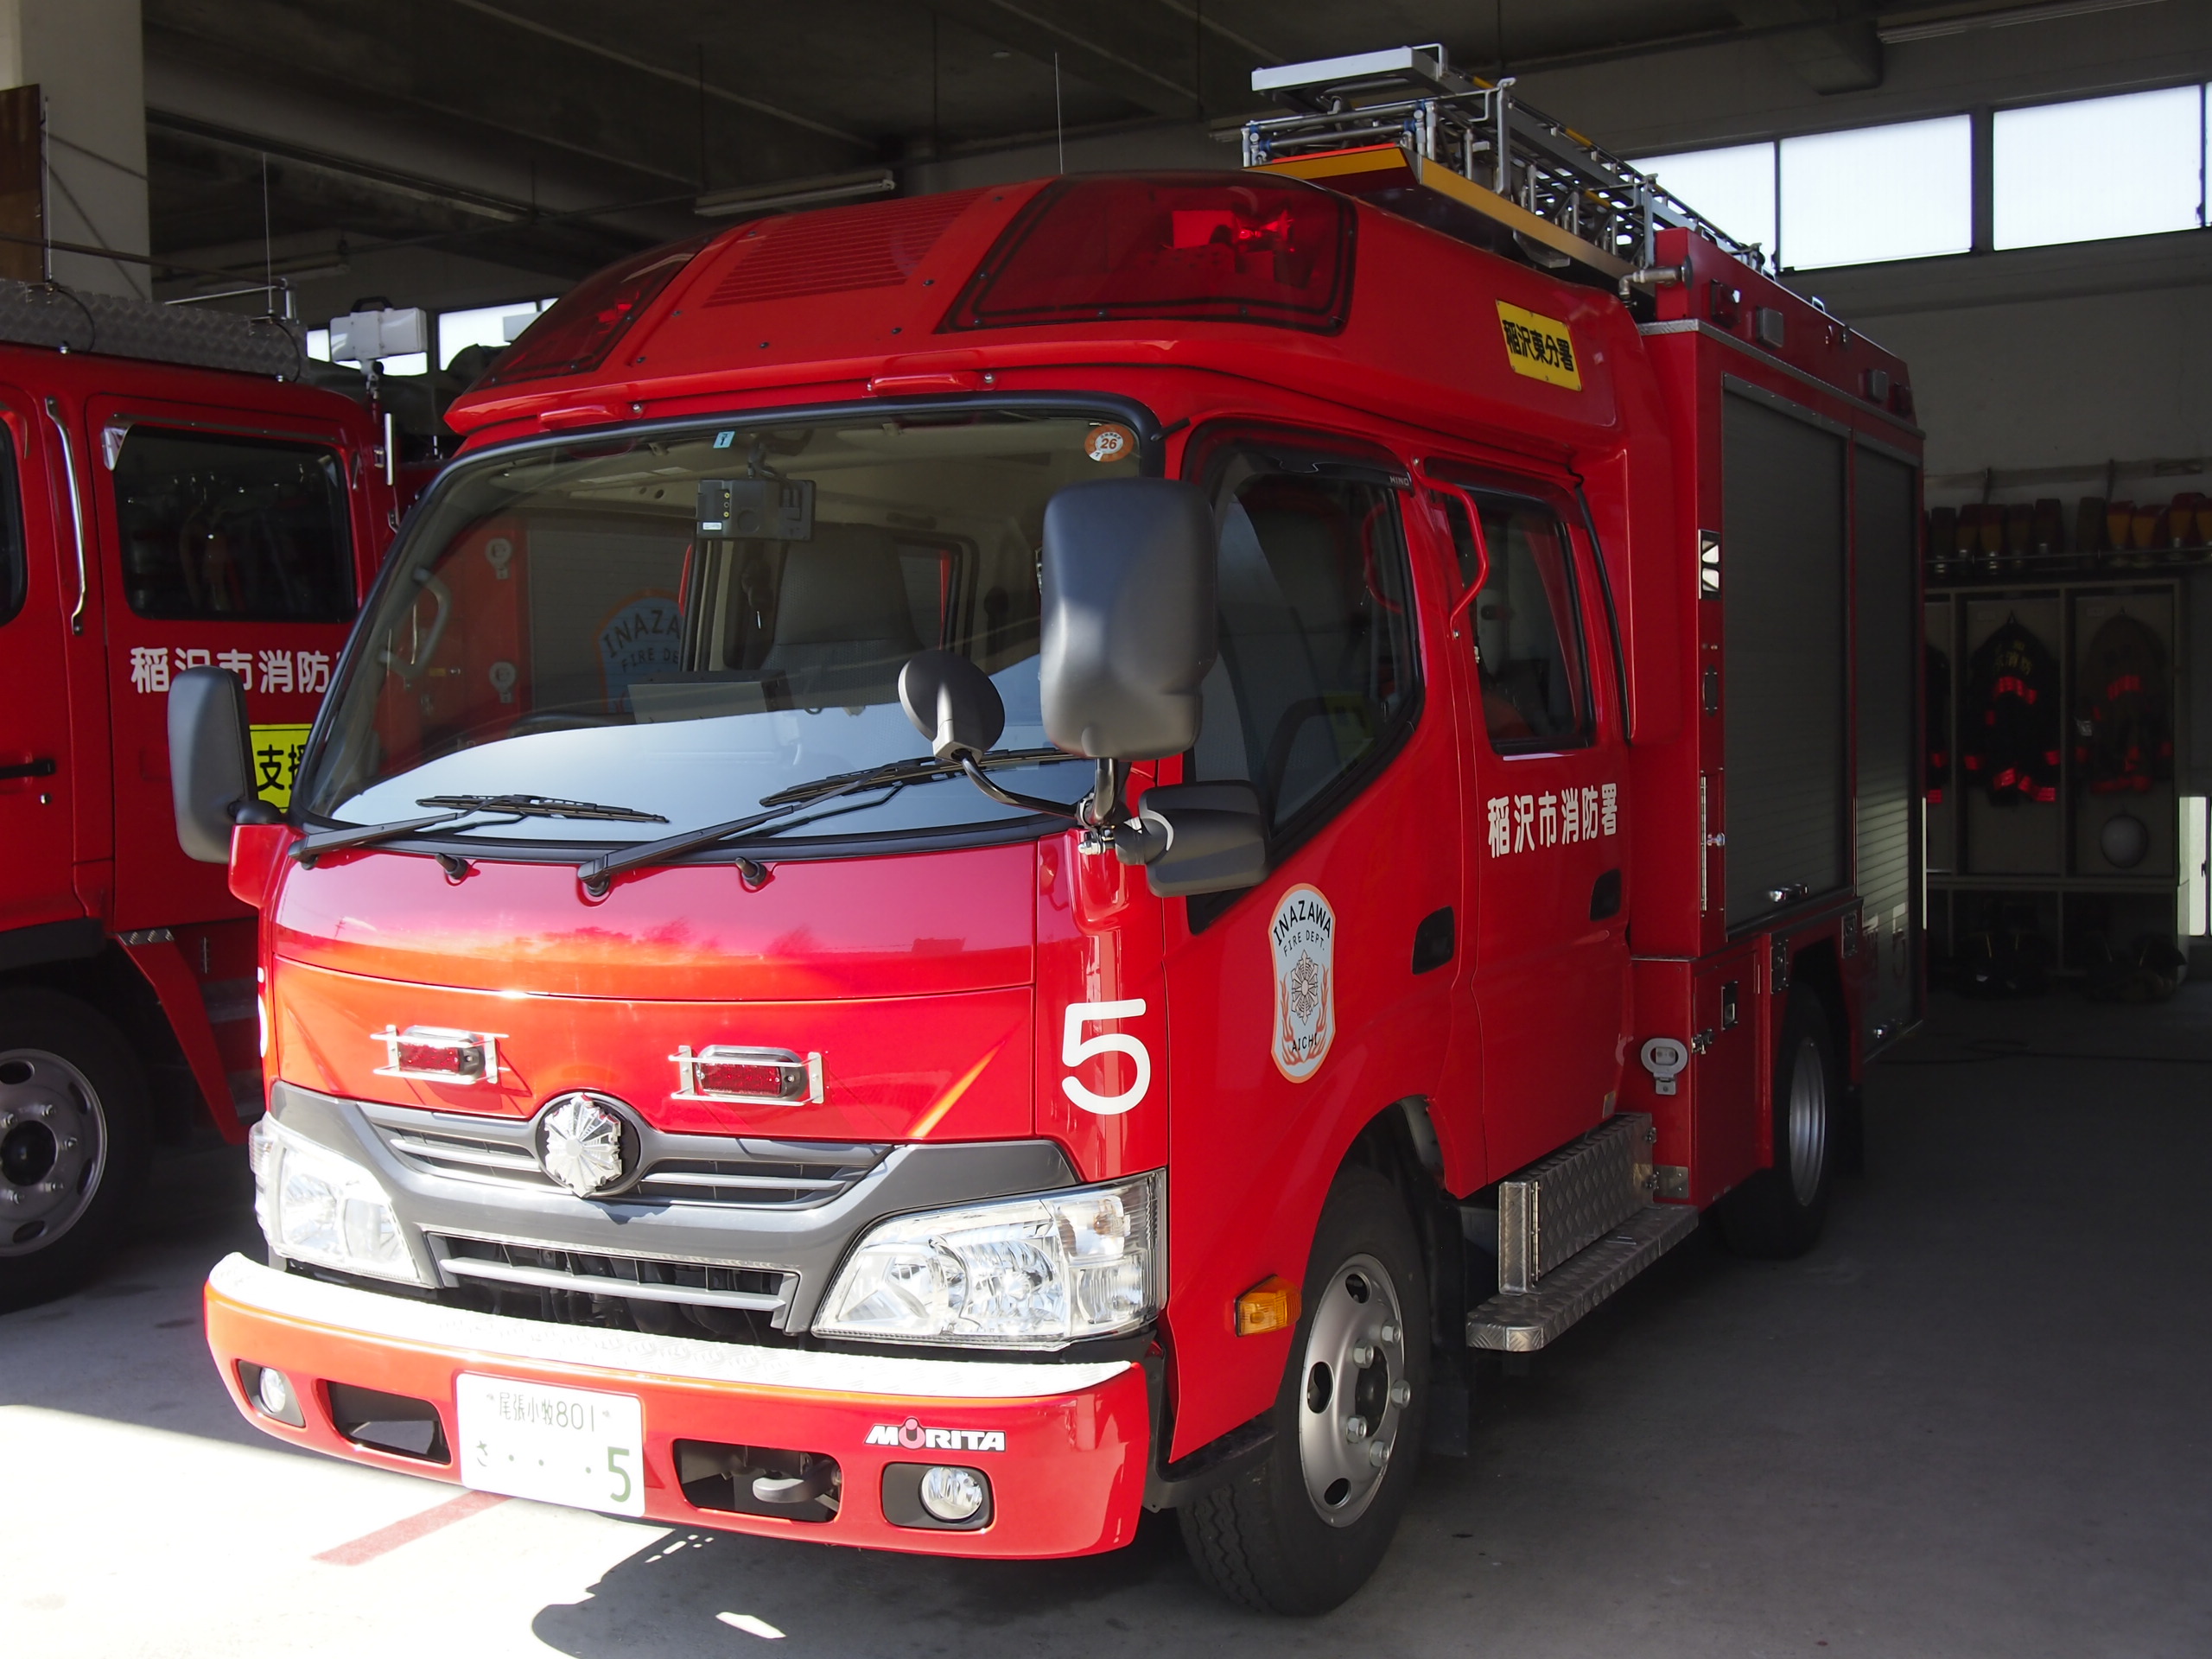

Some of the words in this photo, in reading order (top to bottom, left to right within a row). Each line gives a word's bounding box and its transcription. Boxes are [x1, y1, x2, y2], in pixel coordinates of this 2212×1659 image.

[1502, 319, 1574, 372] 稲沢東分署
[1100, 437, 1117, 449] 26
[1389, 475, 1409, 486] HINO
[130, 646, 341, 693] 稲市消防
[620, 647, 656, 673] FIRE
[1487, 783, 1618, 859] 稲沢市消防署
[1273, 899, 1332, 946] INAZAWA
[1283, 930, 1302, 957] FIRE
[1306, 929, 1325, 951] DEPT.
[1062, 998, 1151, 1116] 5
[1291, 1033, 1319, 1053] AICHI
[865, 1417, 1007, 1452] MORITA
